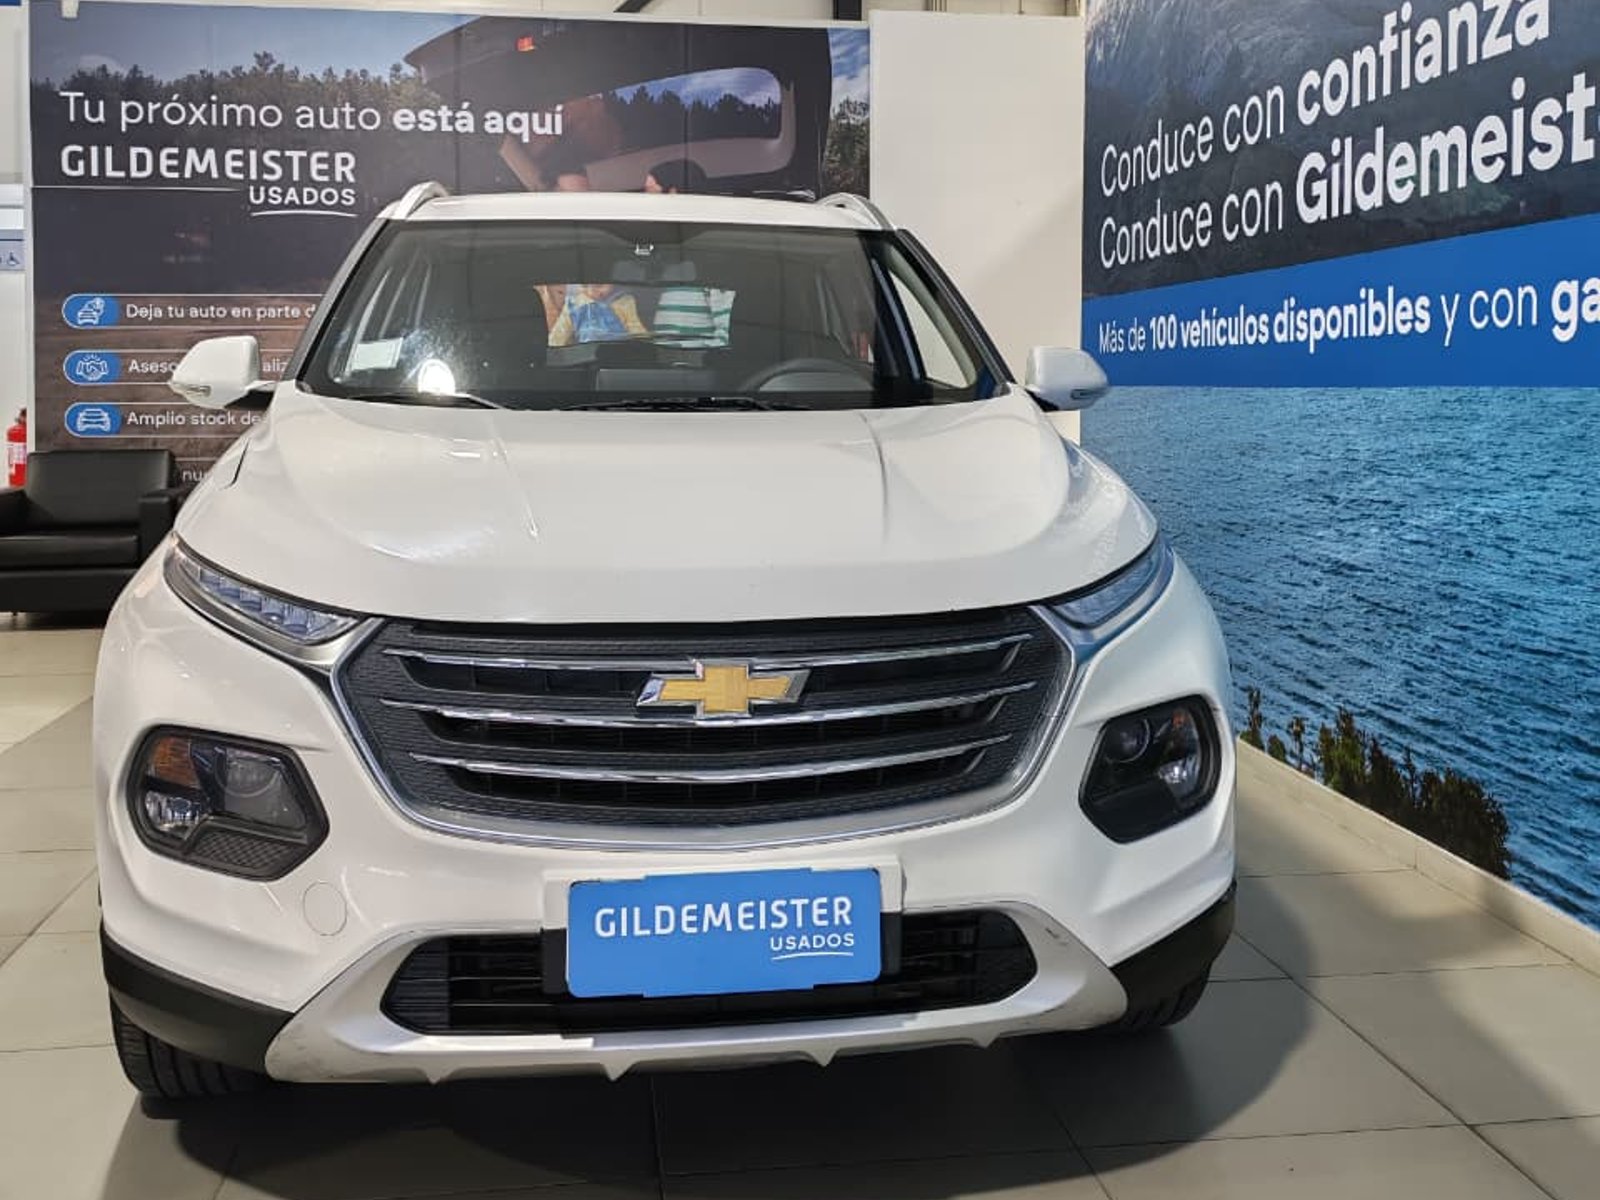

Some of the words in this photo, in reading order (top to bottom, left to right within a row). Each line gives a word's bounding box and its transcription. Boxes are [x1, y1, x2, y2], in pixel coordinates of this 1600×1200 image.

[60, 92, 104, 123] Tu
[121, 94, 282, 132] próximo
[296, 101, 380, 130] auto
[393, 102, 474, 133] está
[485, 105, 562, 142] aquí
[1101, 119, 1214, 197] Conduce
[1223, 85, 1284, 152] con
[1297, 0, 1549, 125] confianza
[61, 144, 356, 183] GILDEMEISTER
[1101, 198, 1213, 268] Conduce
[1222, 181, 1283, 241] con
[1296, 72, 1600, 224] Gildemeist
[249, 186, 356, 206] USADOS
[126, 303, 163, 321] Deja
[168, 304, 185, 319] tu
[189, 303, 227, 319] auto
[231, 306, 252, 319] en
[256, 304, 301, 322] parte
[1099, 320, 1124, 355] Más
[1127, 317, 1146, 351] de
[1150, 314, 1177, 350] 100
[1180, 304, 1269, 348] vehículos
[1273, 285, 1431, 354] disponibles
[1440, 293, 1460, 347] y
[1469, 284, 1538, 330] con
[127, 411, 186, 429] Amplio
[191, 411, 236, 426] stock
[240, 411, 263, 426] de
[594, 896, 853, 938] GILDEMEISTER
[769, 933, 856, 952] USADOS
